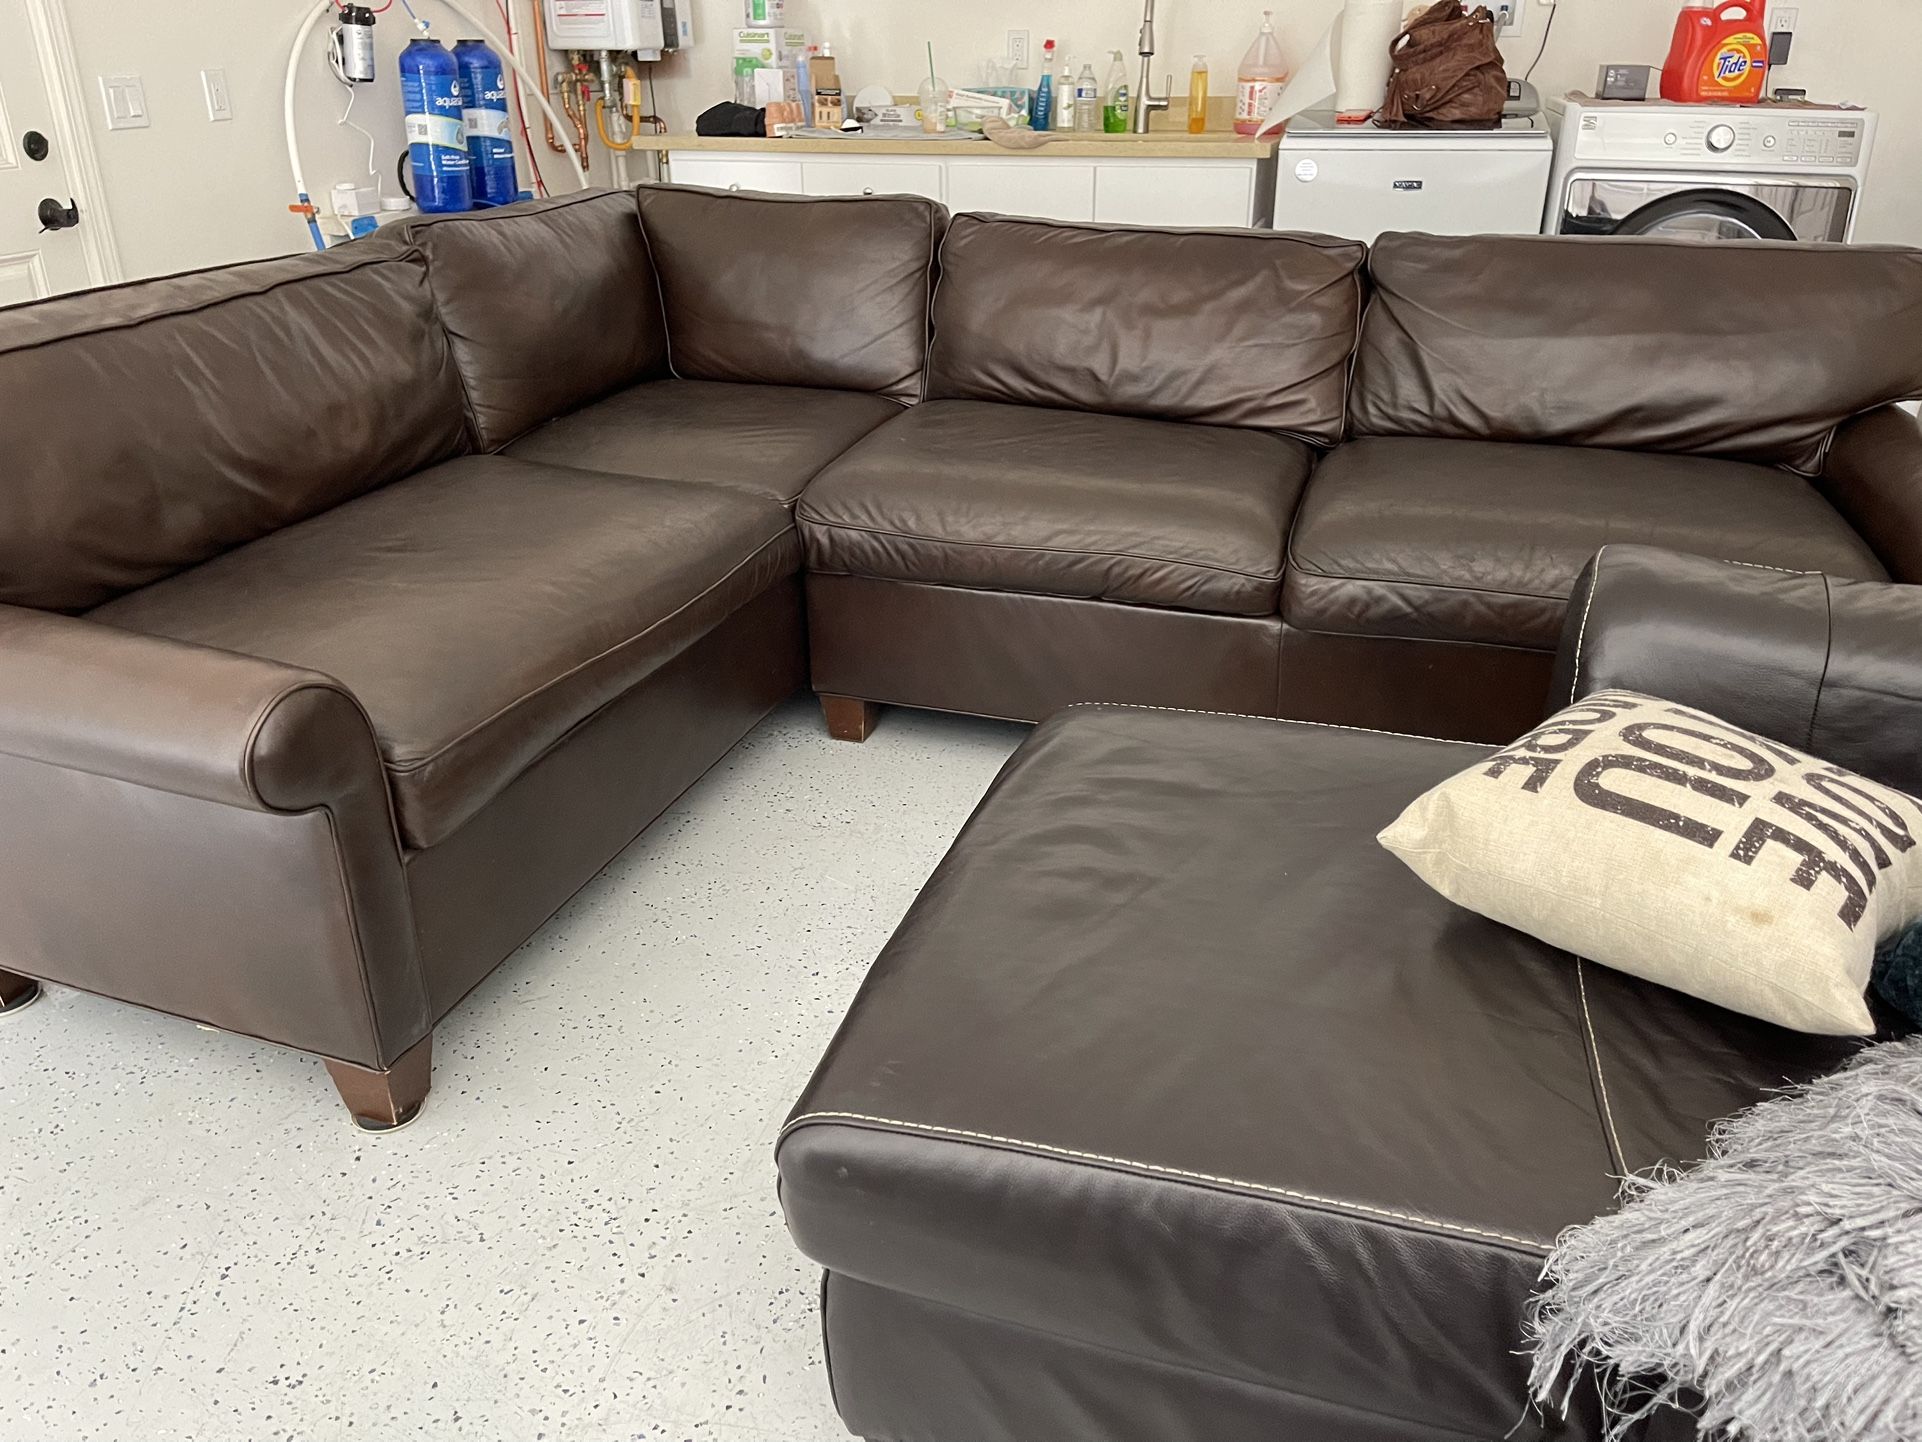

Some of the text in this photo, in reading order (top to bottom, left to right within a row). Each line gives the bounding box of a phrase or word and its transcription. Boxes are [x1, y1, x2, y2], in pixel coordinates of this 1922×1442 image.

[739, 31, 769, 39] Cuisinart
[1717, 54, 1748, 79] Tide
[1482, 688, 1664, 794] MORE
[1573, 706, 1802, 849] YOU
